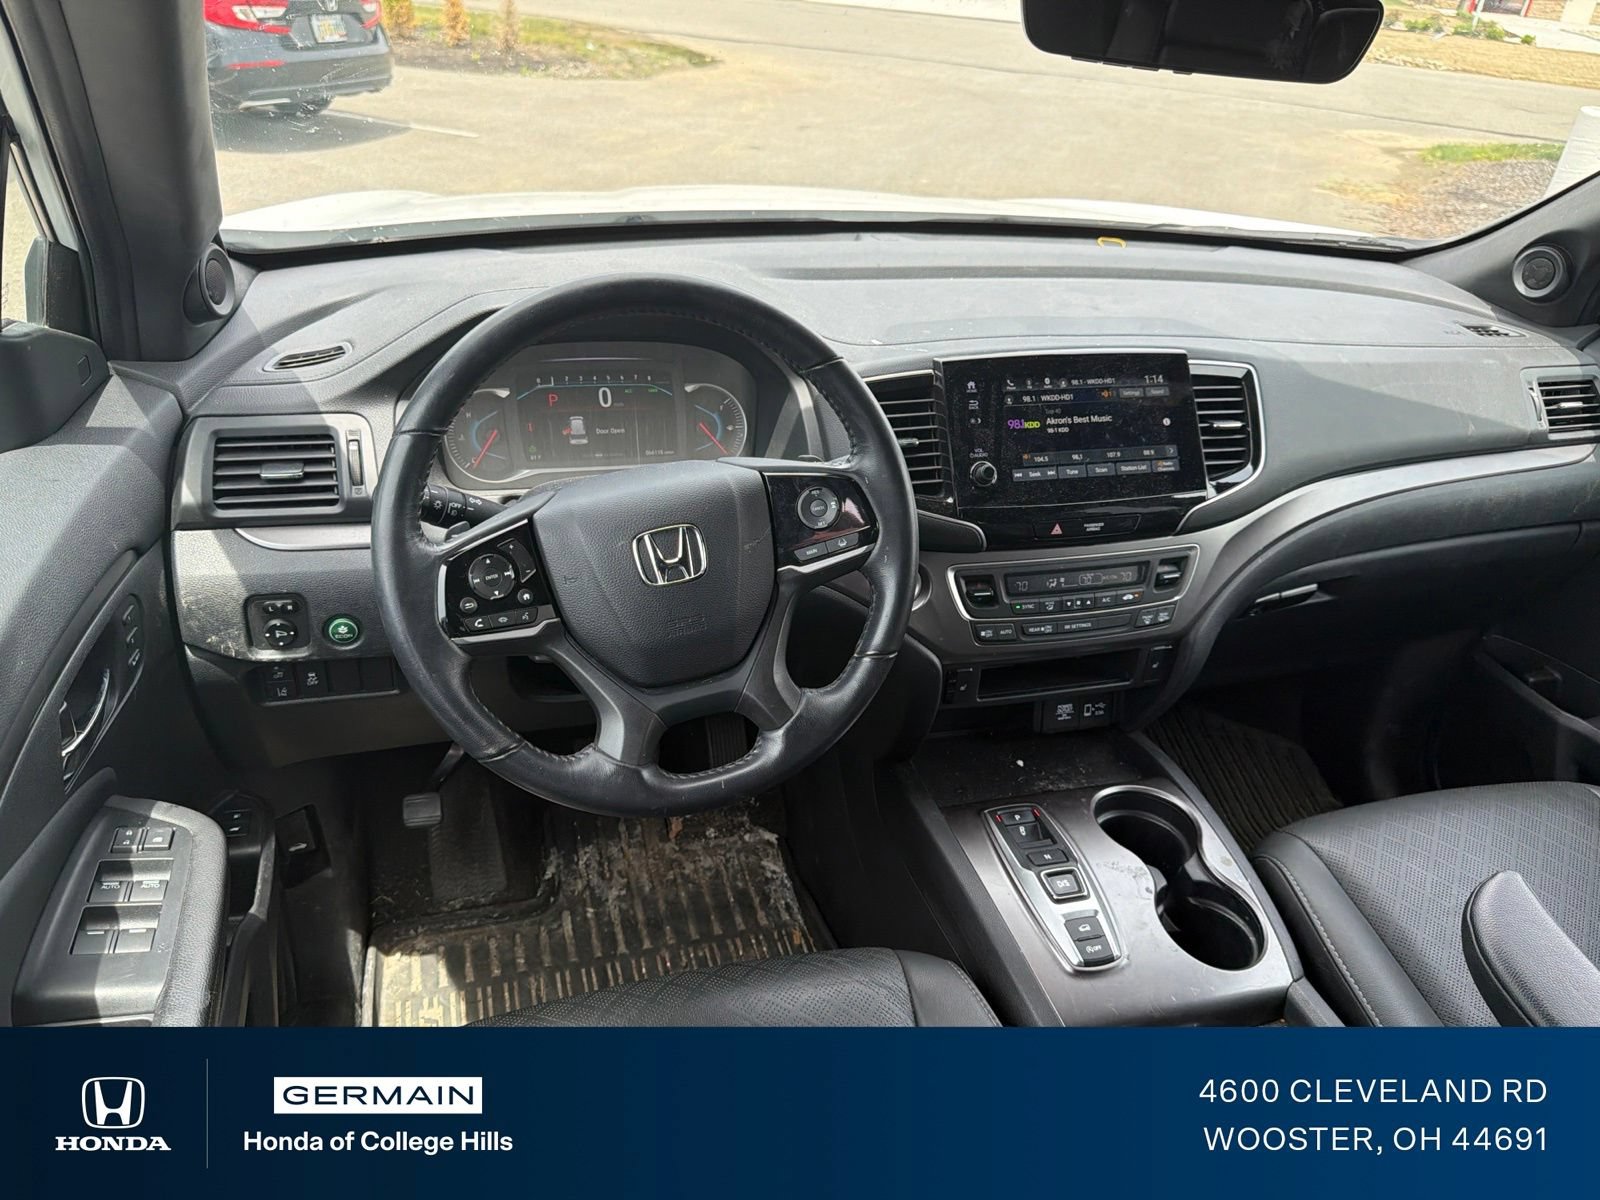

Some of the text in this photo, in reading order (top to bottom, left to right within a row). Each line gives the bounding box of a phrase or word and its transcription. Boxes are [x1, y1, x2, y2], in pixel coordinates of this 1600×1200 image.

[1144, 374, 1164, 384] 1:14
[548, 393, 558, 407] P
[598, 387, 612, 408] 0
[1046, 415, 1112, 425] Akron's Best Music
[610, 427, 625, 436] Open
